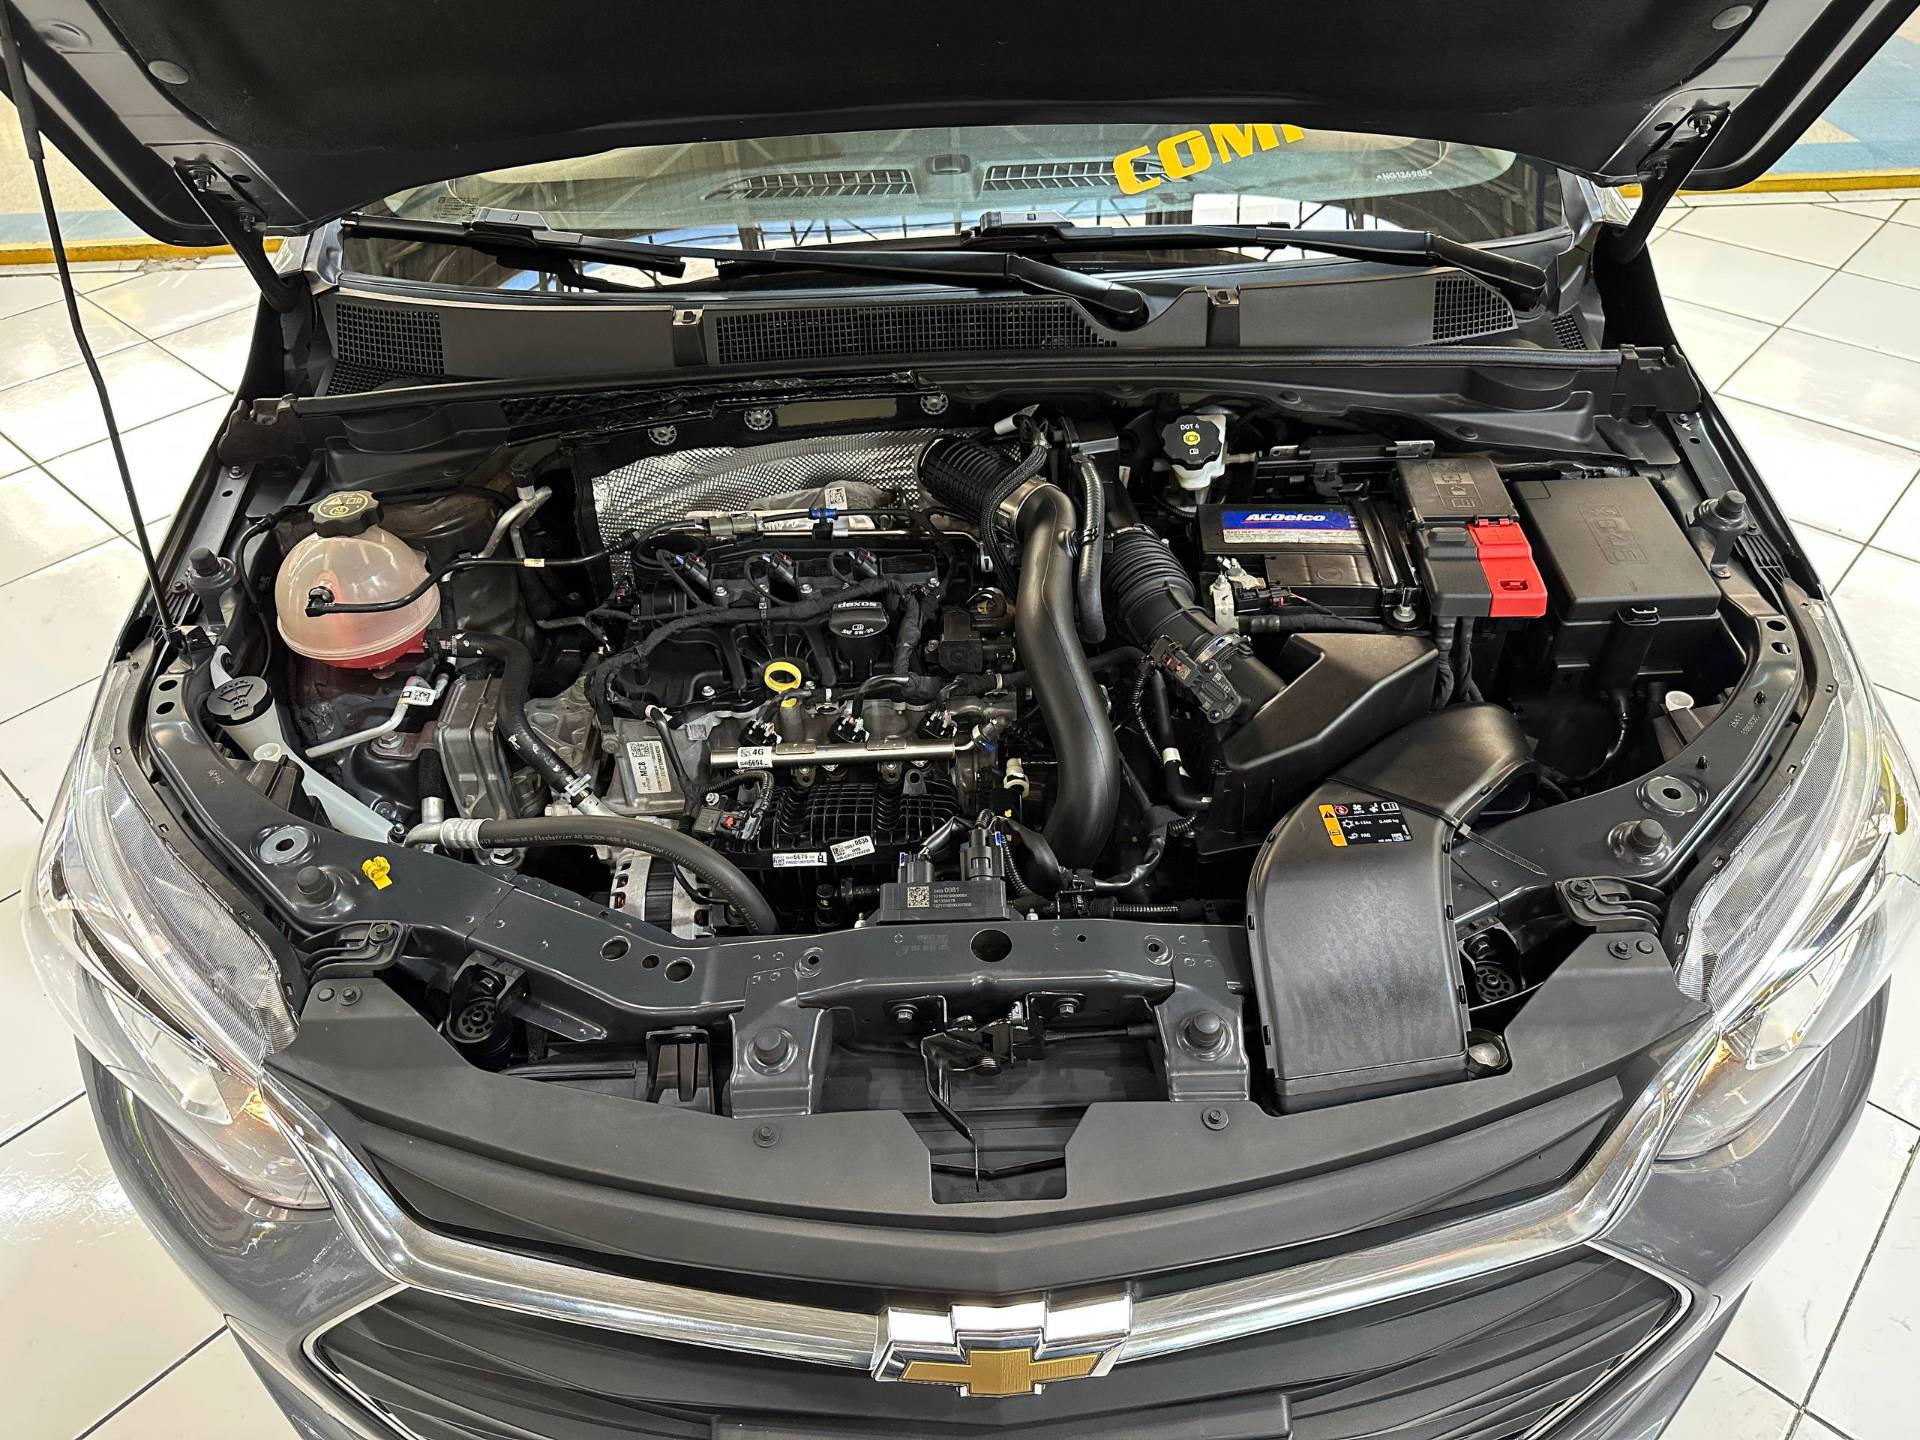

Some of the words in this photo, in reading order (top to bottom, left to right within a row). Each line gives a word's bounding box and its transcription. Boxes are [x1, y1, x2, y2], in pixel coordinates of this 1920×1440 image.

[1112, 123, 1304, 195] COM
[1245, 513, 1326, 522] ACDelco
[752, 748, 764, 756] 4G
